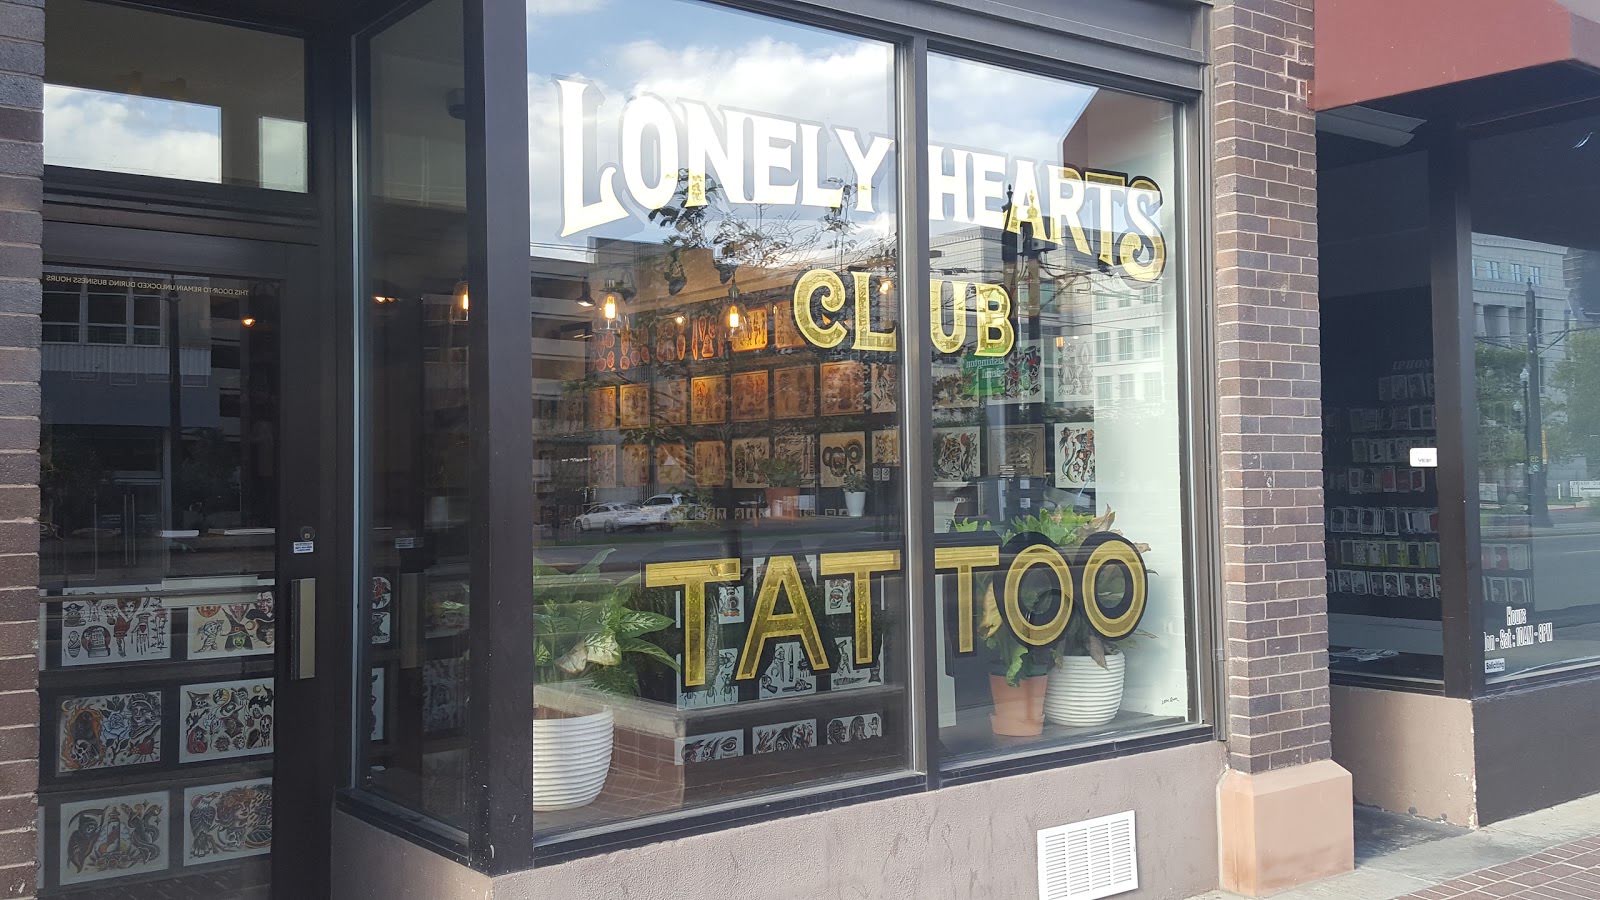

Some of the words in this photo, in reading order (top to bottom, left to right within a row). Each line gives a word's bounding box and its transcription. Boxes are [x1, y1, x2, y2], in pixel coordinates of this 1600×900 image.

[554, 76, 896, 238] LONELY
[928, 143, 1167, 283] HEARTS
[792, 268, 1015, 357] CLUB
[645, 539, 1148, 687] TATTOO
[1506, 606, 1527, 626] Hours
